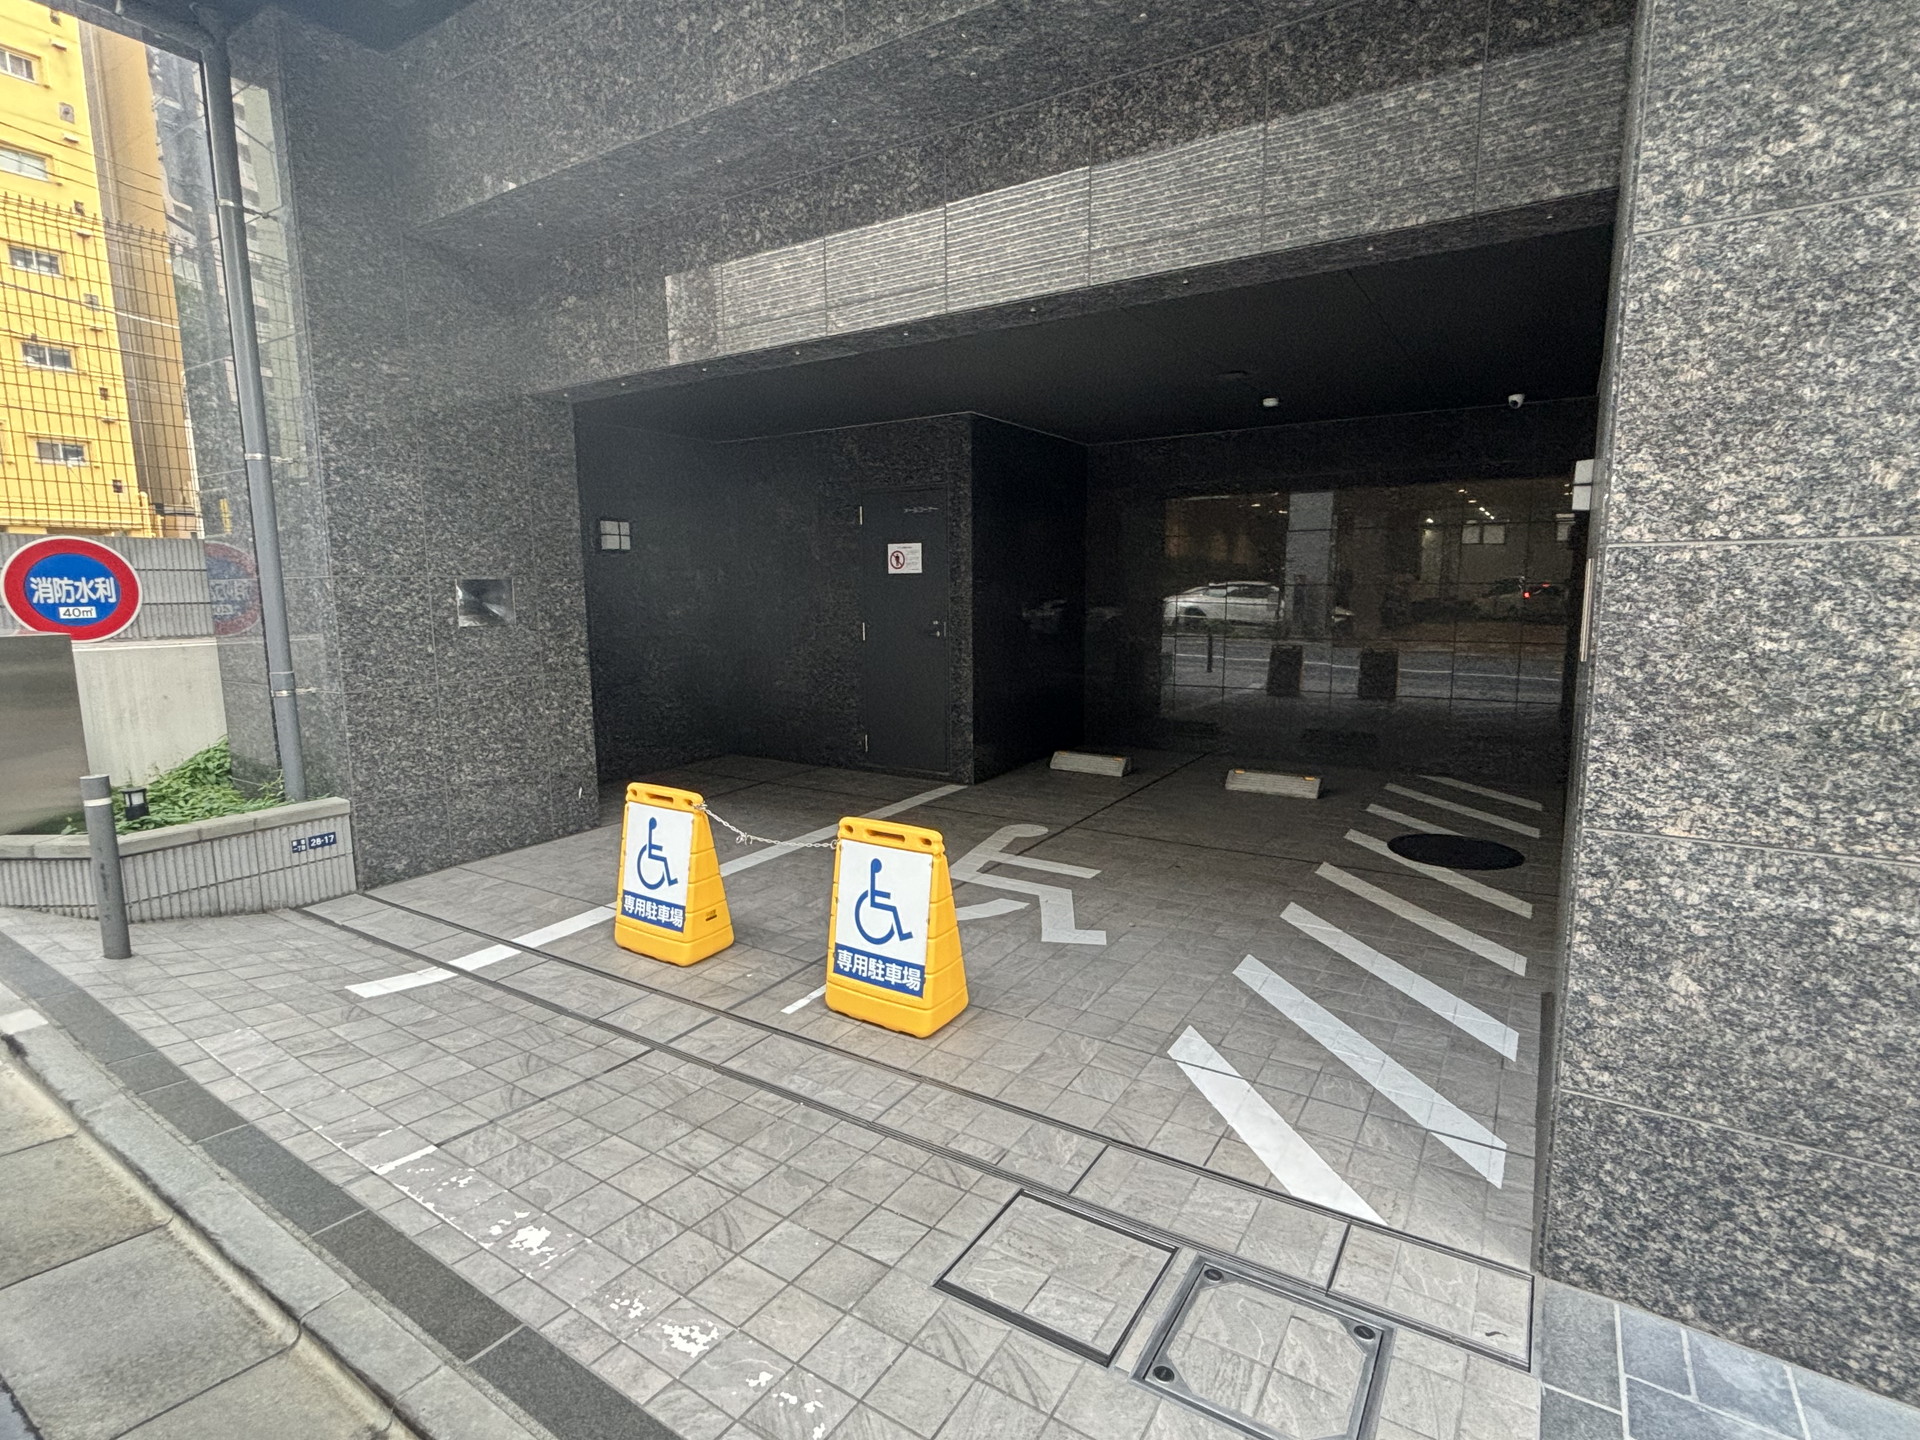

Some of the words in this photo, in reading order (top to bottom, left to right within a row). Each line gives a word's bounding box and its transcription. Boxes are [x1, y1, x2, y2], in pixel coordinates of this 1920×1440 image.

[30, 577, 117, 604] 消防水利
[310, 834, 334, 847] 28-17
[624, 895, 683, 927] 専用駐車場
[837, 949, 921, 991] 専用駐車場
